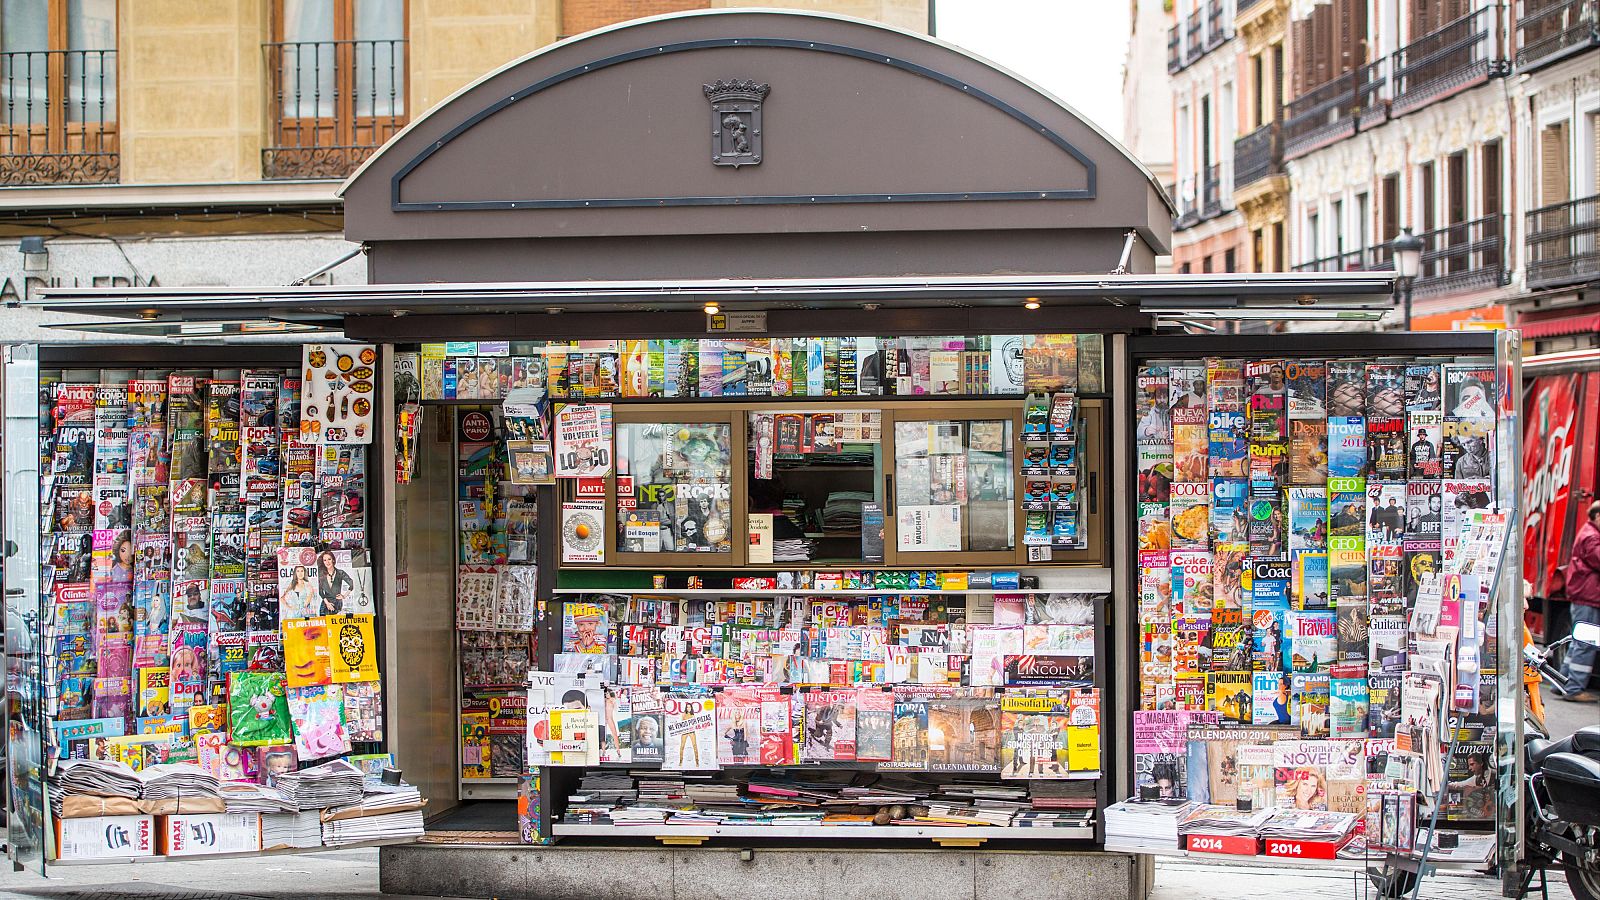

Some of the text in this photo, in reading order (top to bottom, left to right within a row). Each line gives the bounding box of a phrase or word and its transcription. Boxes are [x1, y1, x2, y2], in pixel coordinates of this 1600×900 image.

[1211, 414, 1245, 429] bike
[563, 430, 599, 440] VOLVERTE
[1330, 480, 1357, 491] GEO
[1330, 538, 1357, 550] GEO
[280, 568, 318, 578] GLAUR
[226, 650, 244, 659] 322
[1017, 666, 1076, 676] LINCOLN
[489, 698, 501, 719] 9
[1188, 731, 1270, 739] CALENDARIO 2014
[1283, 753, 1357, 766] NOVELAS
[1193, 838, 1222, 850] 2014
[1271, 843, 1302, 855] 2014
